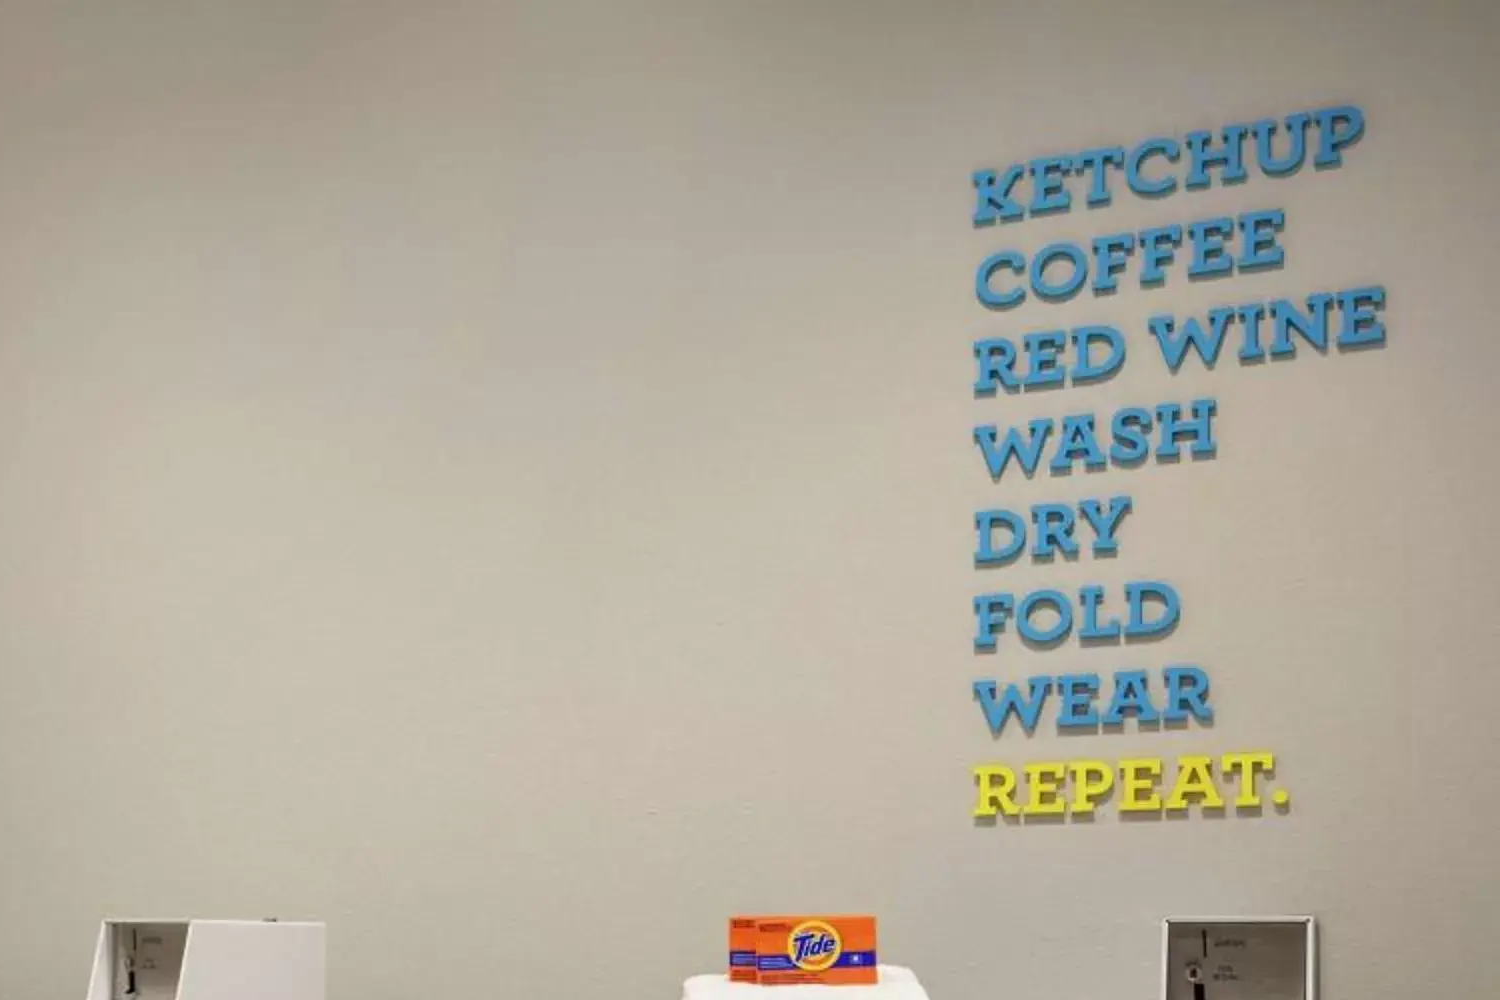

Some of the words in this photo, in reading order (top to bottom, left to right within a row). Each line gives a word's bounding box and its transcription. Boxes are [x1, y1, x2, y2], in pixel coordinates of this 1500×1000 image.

[971, 105, 1366, 226] KETCHUP
[975, 207, 1286, 309] COFFEE
[972, 325, 1127, 396] RED
[1148, 285, 1387, 374] WINE
[972, 398, 1218, 482] WASH
[973, 496, 1133, 568] DRY
[972, 580, 1182, 652] FOLD
[972, 666, 1215, 739] WEAR
[972, 752, 1289, 819] REPEAT.
[793, 933, 836, 962] Tide
